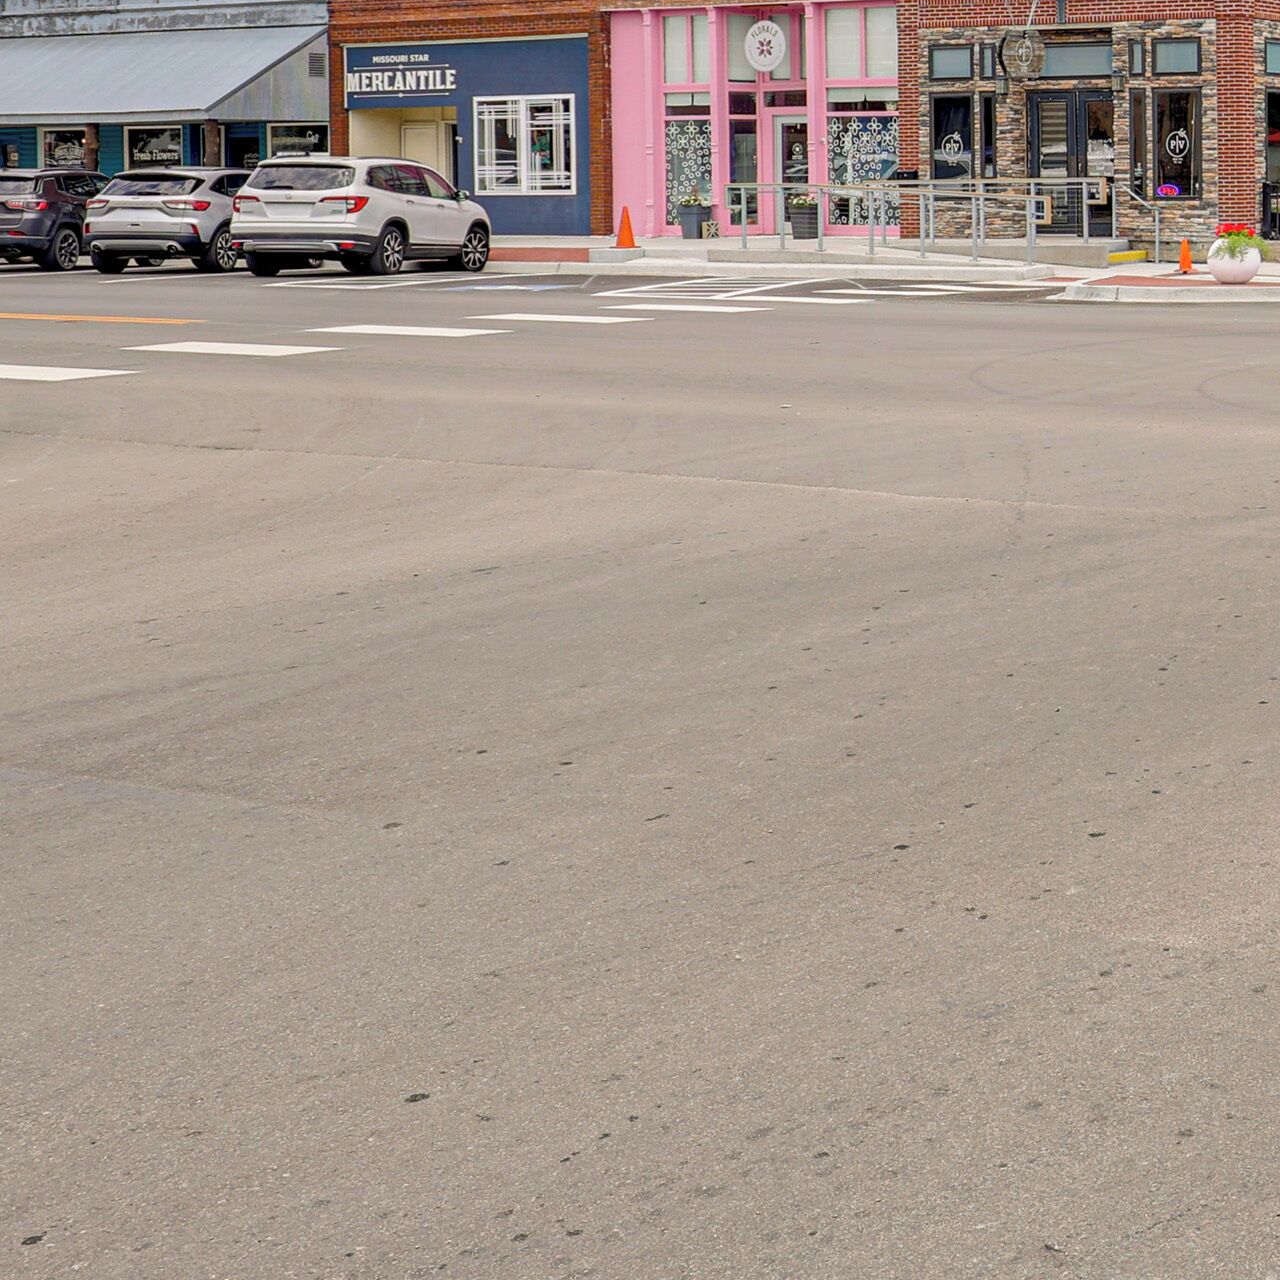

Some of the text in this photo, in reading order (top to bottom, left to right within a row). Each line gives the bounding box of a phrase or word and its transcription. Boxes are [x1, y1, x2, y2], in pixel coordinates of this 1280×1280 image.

[751, 25, 779, 39] FLORALS
[372, 54, 429, 63] MISSOURI STAR
[347, 69, 457, 92] MERCANTILE
[133, 150, 179, 160] Fresh Flowers
